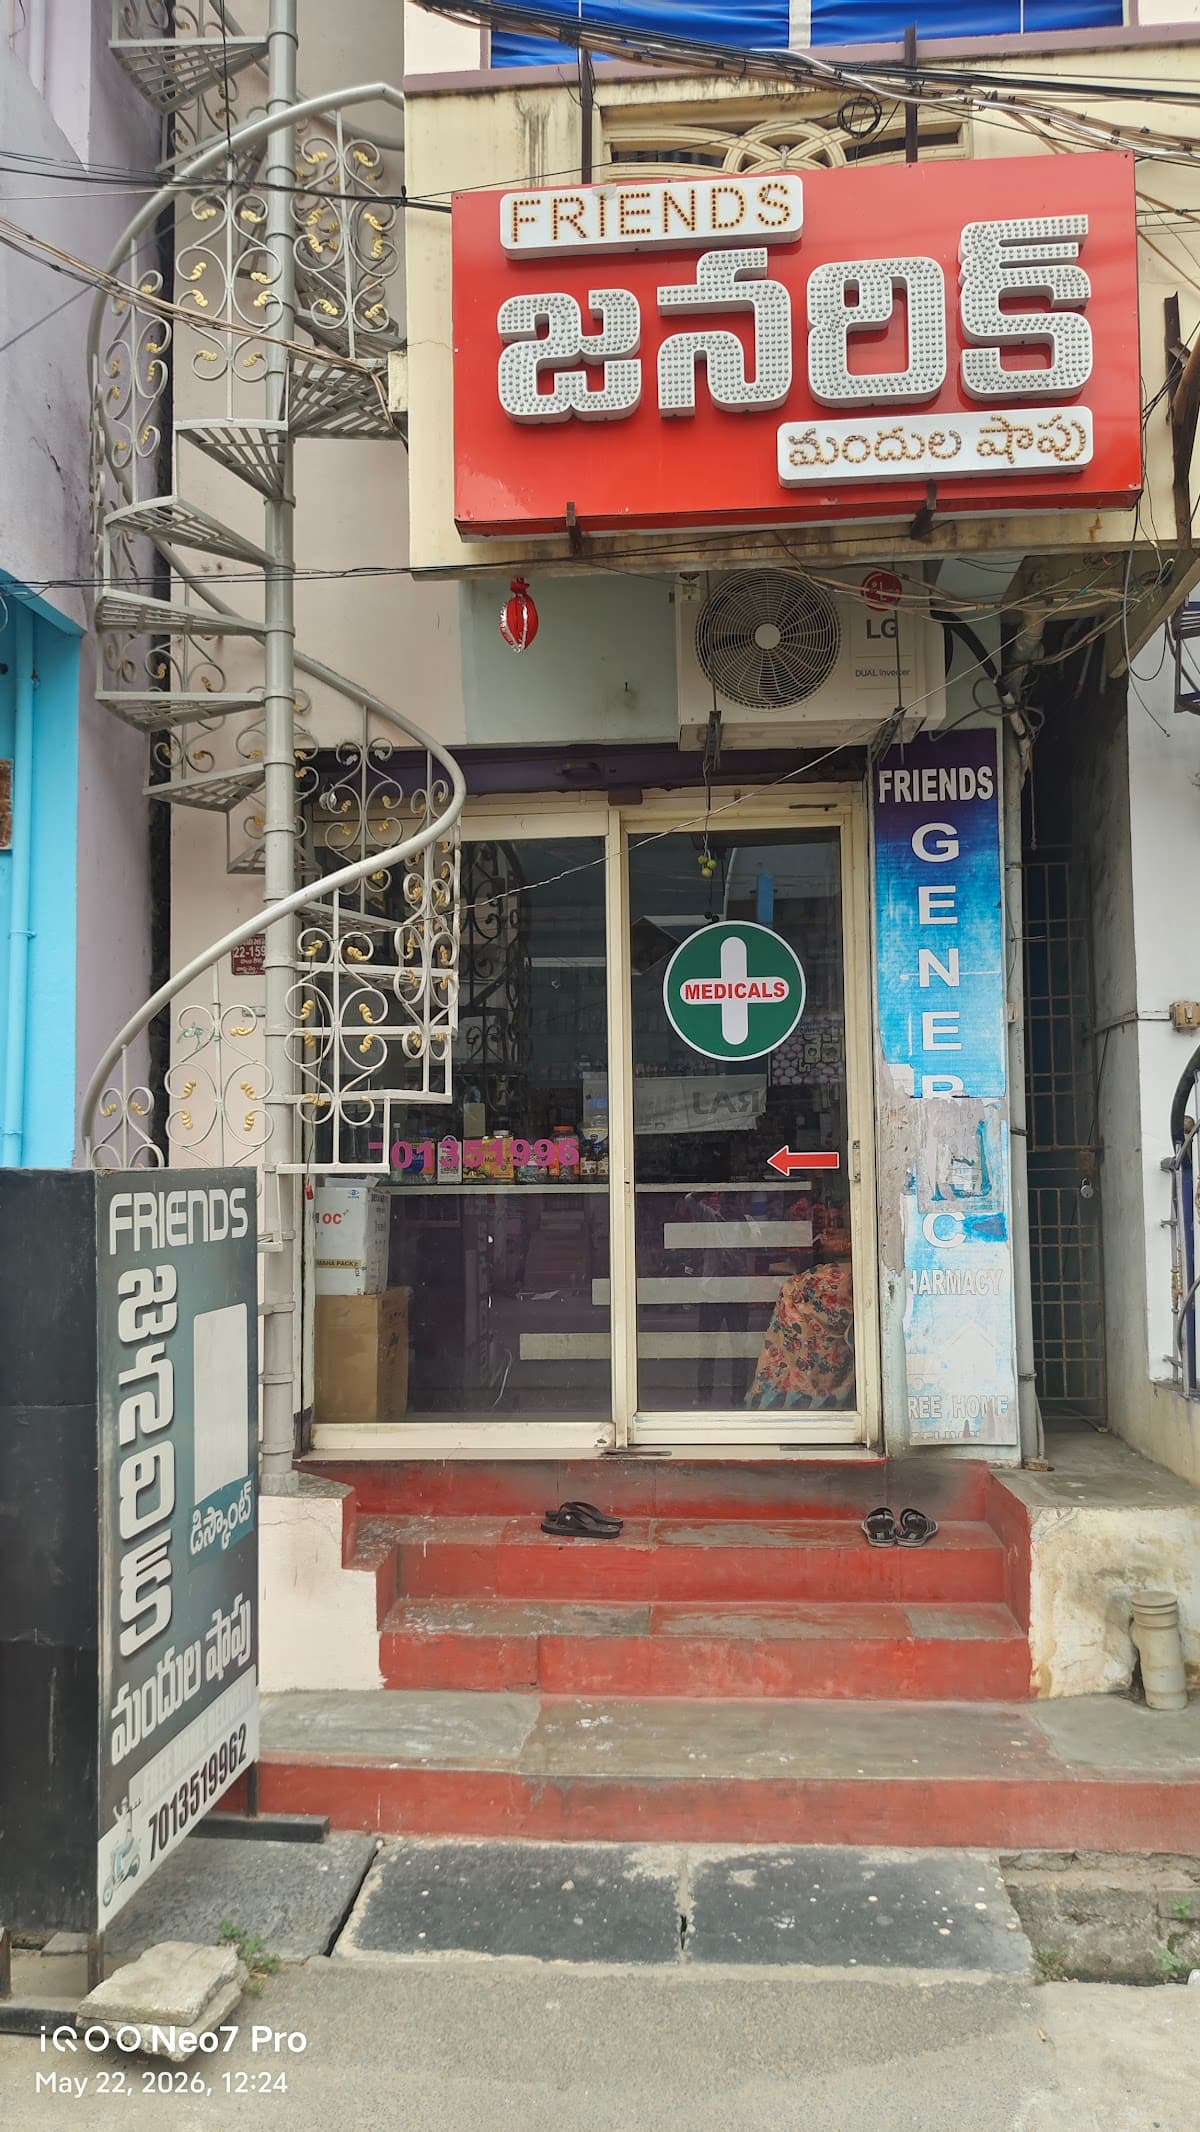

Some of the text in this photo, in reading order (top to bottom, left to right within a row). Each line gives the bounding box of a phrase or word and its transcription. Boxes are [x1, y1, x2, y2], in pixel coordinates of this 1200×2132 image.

[511, 182, 792, 243] FRIENDS
[788, 413, 1087, 466] మందుల షాపు
[866, 618, 898, 639] LG
[855, 668, 878, 677] DUAL
[878, 766, 994, 803] FRIENDS
[684, 982, 785, 1000] MEDICALS
[911, 822, 967, 1249] GENERC
[368, 1138, 580, 1169] 01351996
[109, 1187, 249, 1255] FRIENDS
[907, 1394, 1009, 1419] REE HOME
[111, 1592, 251, 1766] మందుల షాపు
[148, 1722, 248, 1862] 7013519962
